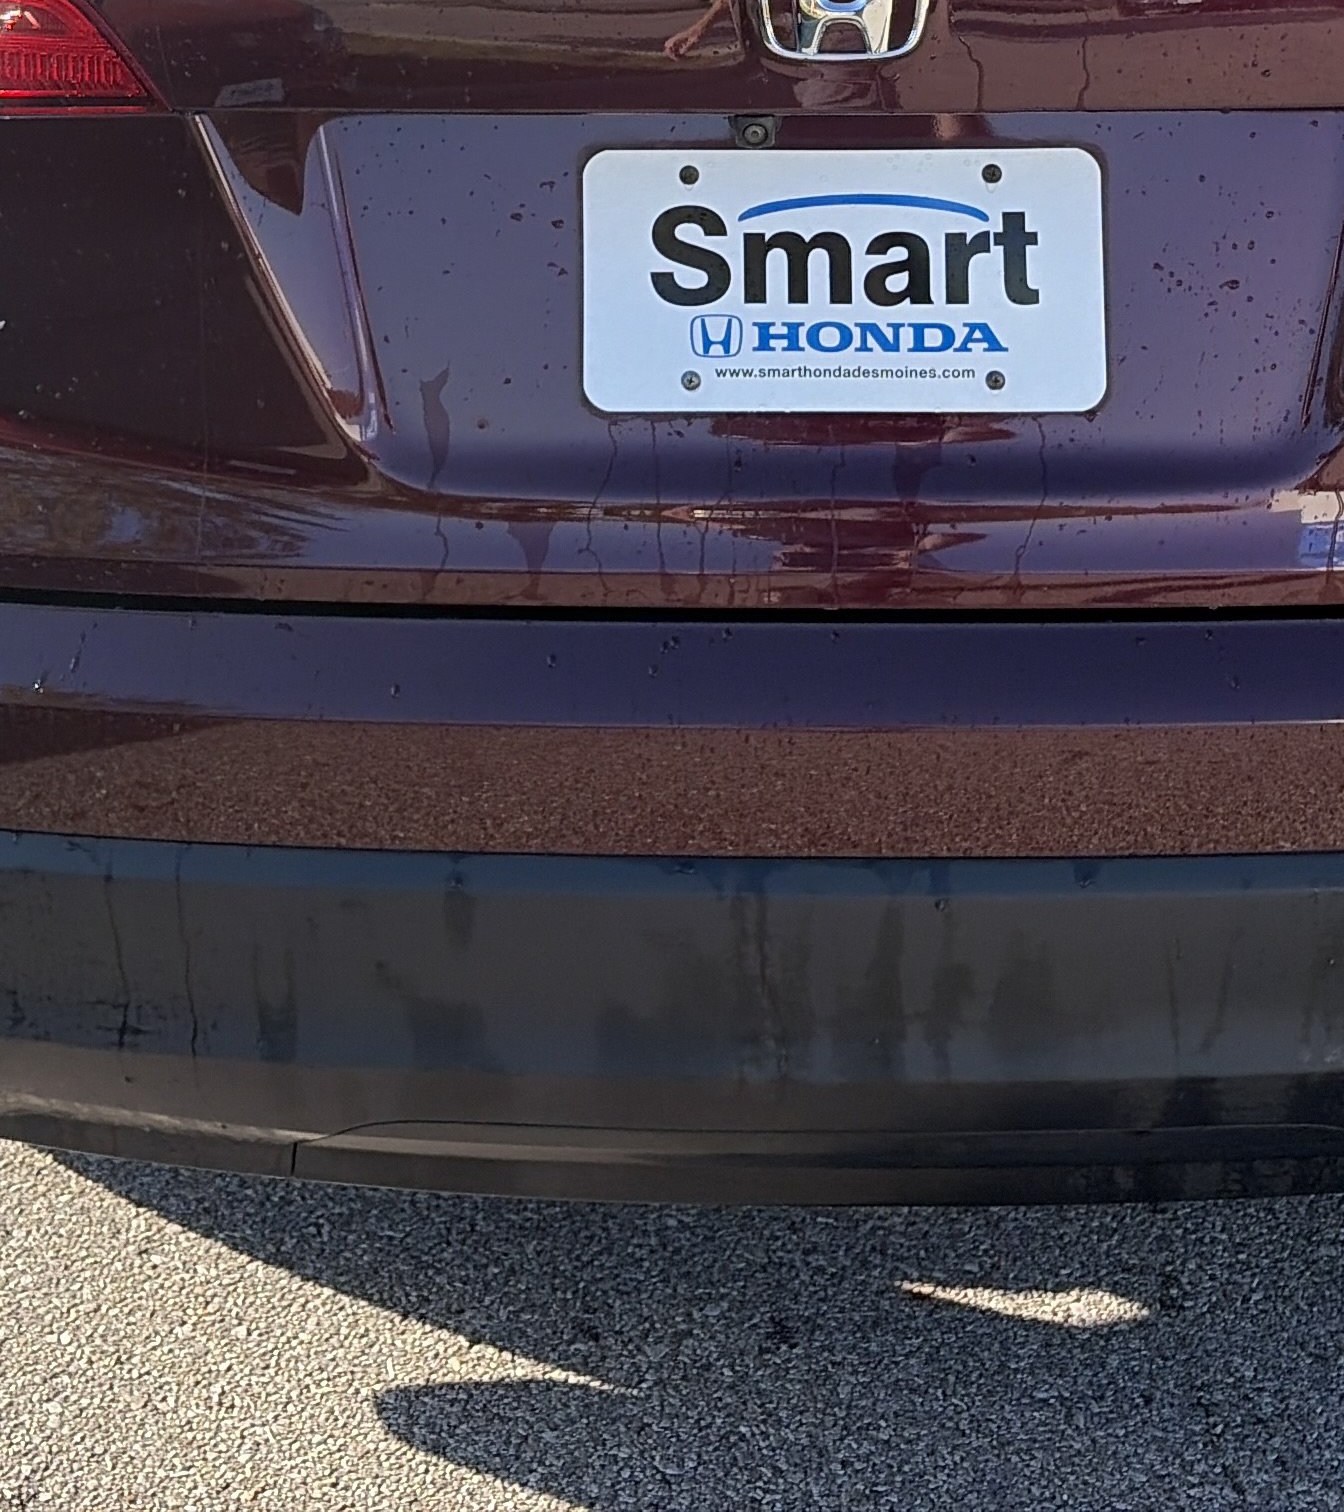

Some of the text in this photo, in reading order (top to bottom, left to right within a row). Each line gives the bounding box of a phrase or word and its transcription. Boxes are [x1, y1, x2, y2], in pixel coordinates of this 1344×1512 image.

[650, 205, 1040, 307] Smart
[751, 321, 1009, 353] HONDA
[714, 366, 976, 380] www.smarthondadesmoines.com
